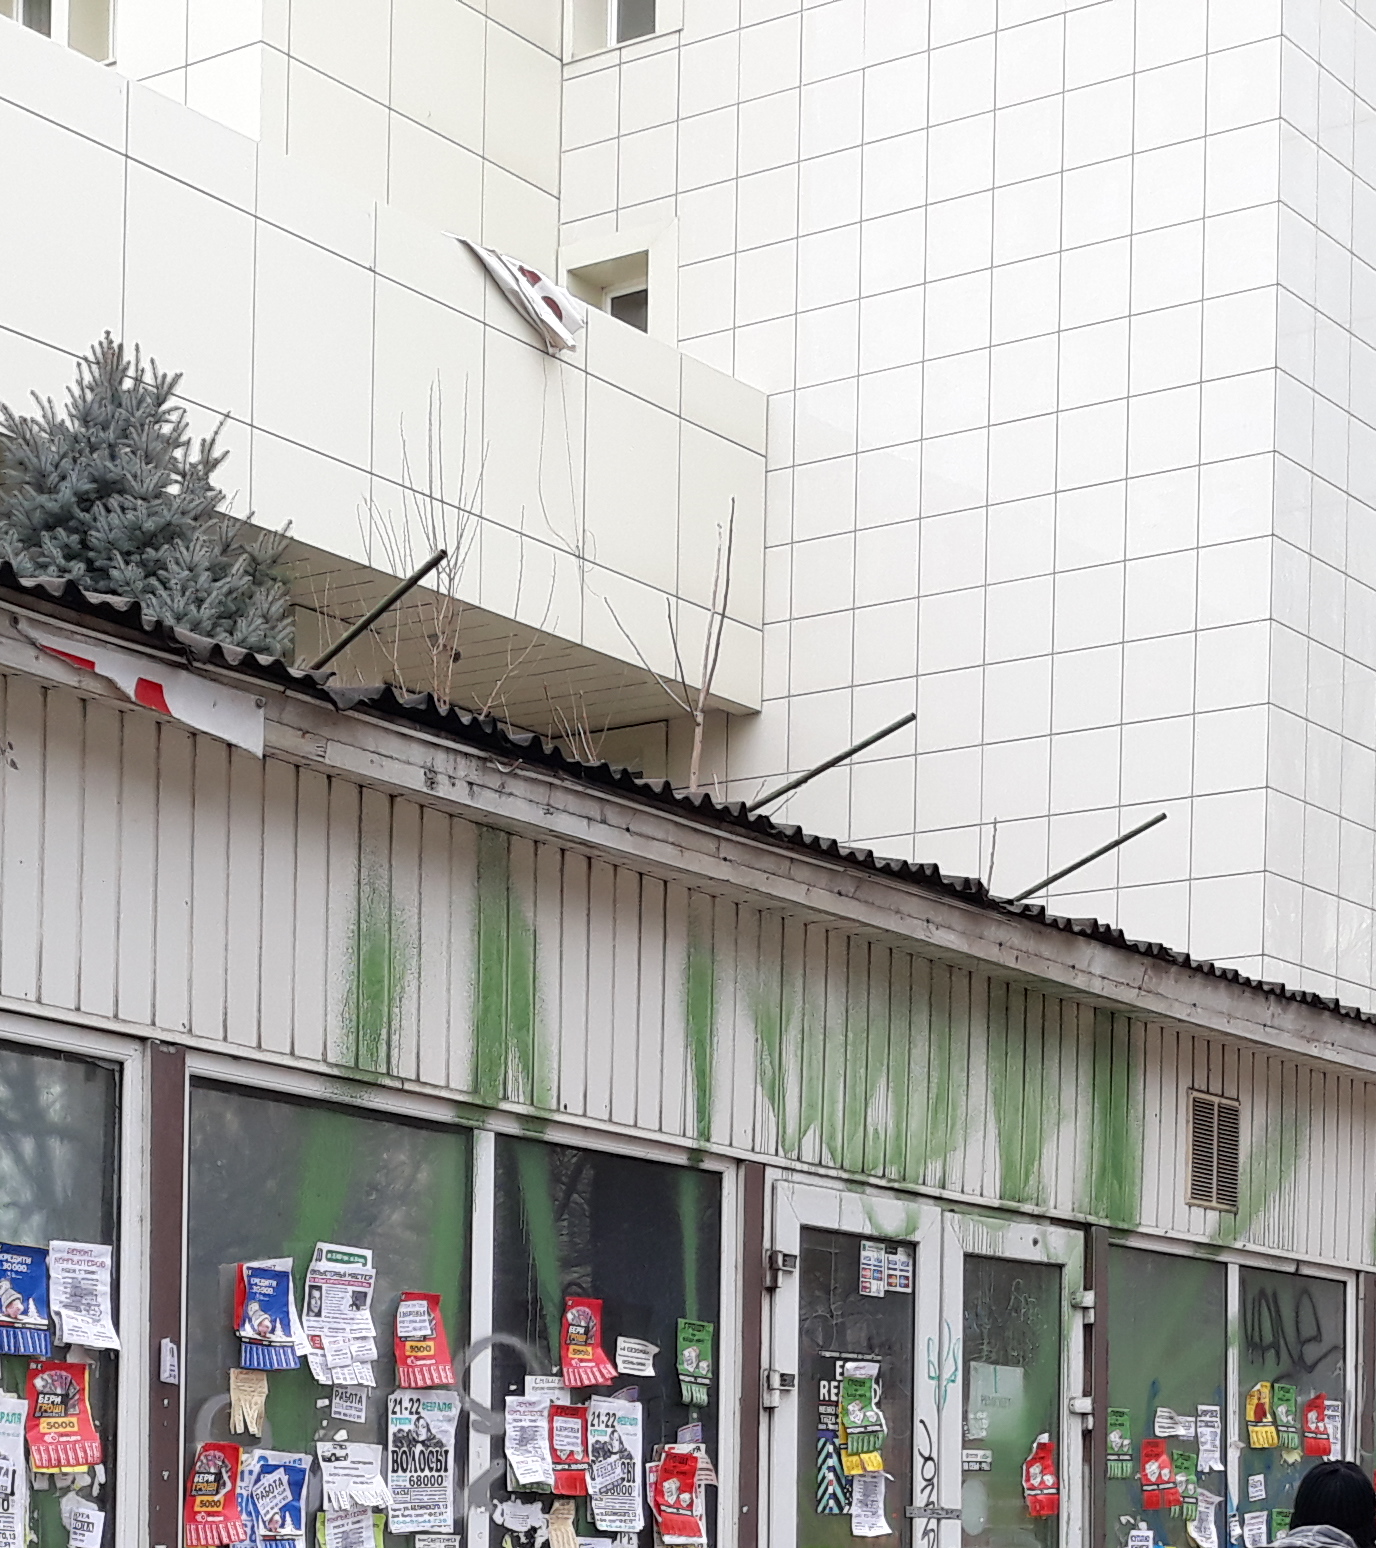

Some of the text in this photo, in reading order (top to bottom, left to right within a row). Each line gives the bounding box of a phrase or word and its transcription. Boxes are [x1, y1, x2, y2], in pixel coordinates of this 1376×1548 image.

[38, 1393, 62, 1405] БЕРИ
[334, 1389, 363, 1405] РАБОТА
[45, 1420, 75, 1430] 5000
[390, 1449, 450, 1474] ВОЛОСЫ
[408, 1474, 444, 1487] 68000
[254, 1476, 284, 1504] РАБОТА
[199, 1499, 222, 1510] 5000
